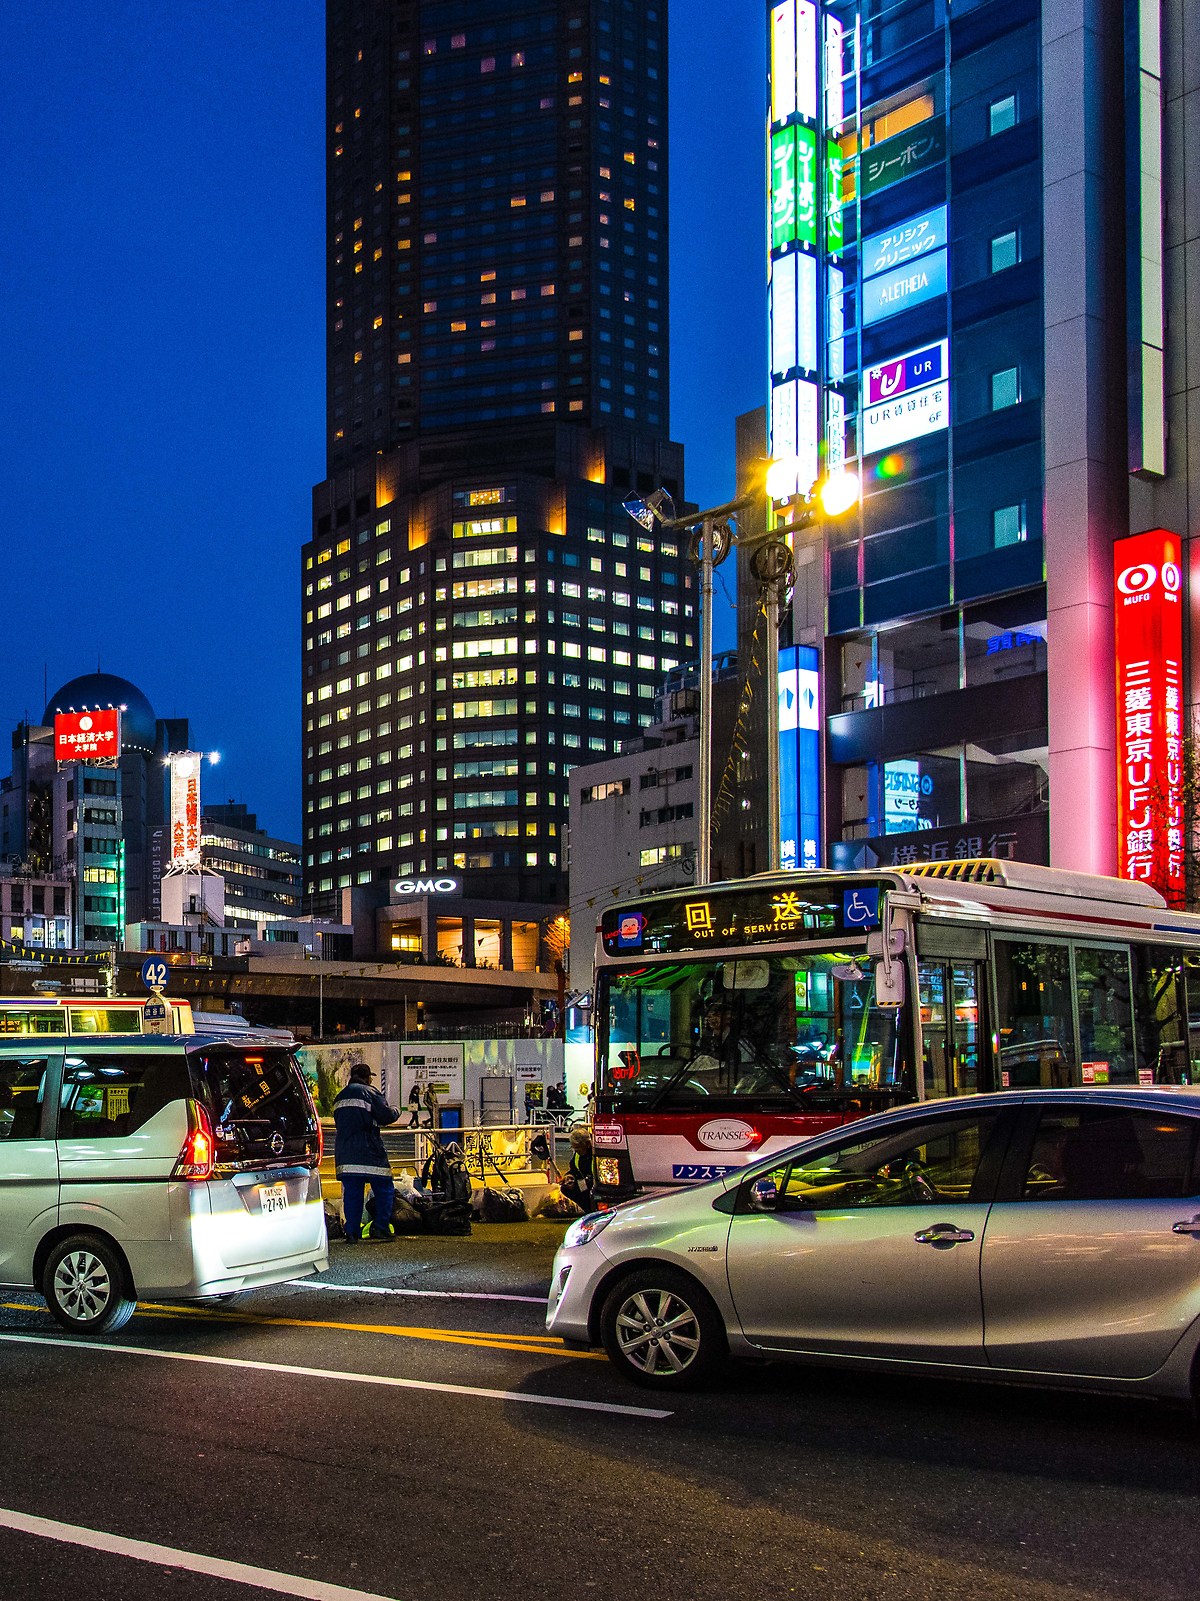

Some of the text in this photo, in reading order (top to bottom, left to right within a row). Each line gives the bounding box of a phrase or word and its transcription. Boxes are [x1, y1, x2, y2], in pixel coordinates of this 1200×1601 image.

[880, 221, 930, 253] アリシア
[874, 235, 936, 271] クリニック
[879, 272, 928, 305] ALETHEIA
[913, 361, 932, 375] UR
[928, 411, 942, 423] 6F
[1123, 593, 1151, 606] MUFG
[59, 730, 115, 745] 日本経済大学
[74, 744, 98, 752] 大学院
[1125, 659, 1153, 881] 三菱東京UFJ銀行
[173, 820, 185, 859] 大学院
[891, 833, 1018, 865] 横浜銀行
[394, 879, 457, 894] GMO
[694, 922, 796, 939] OUT OF SERVICE
[146, 964, 168, 985] 42
[675, 1166, 733, 1178] ノンステ
